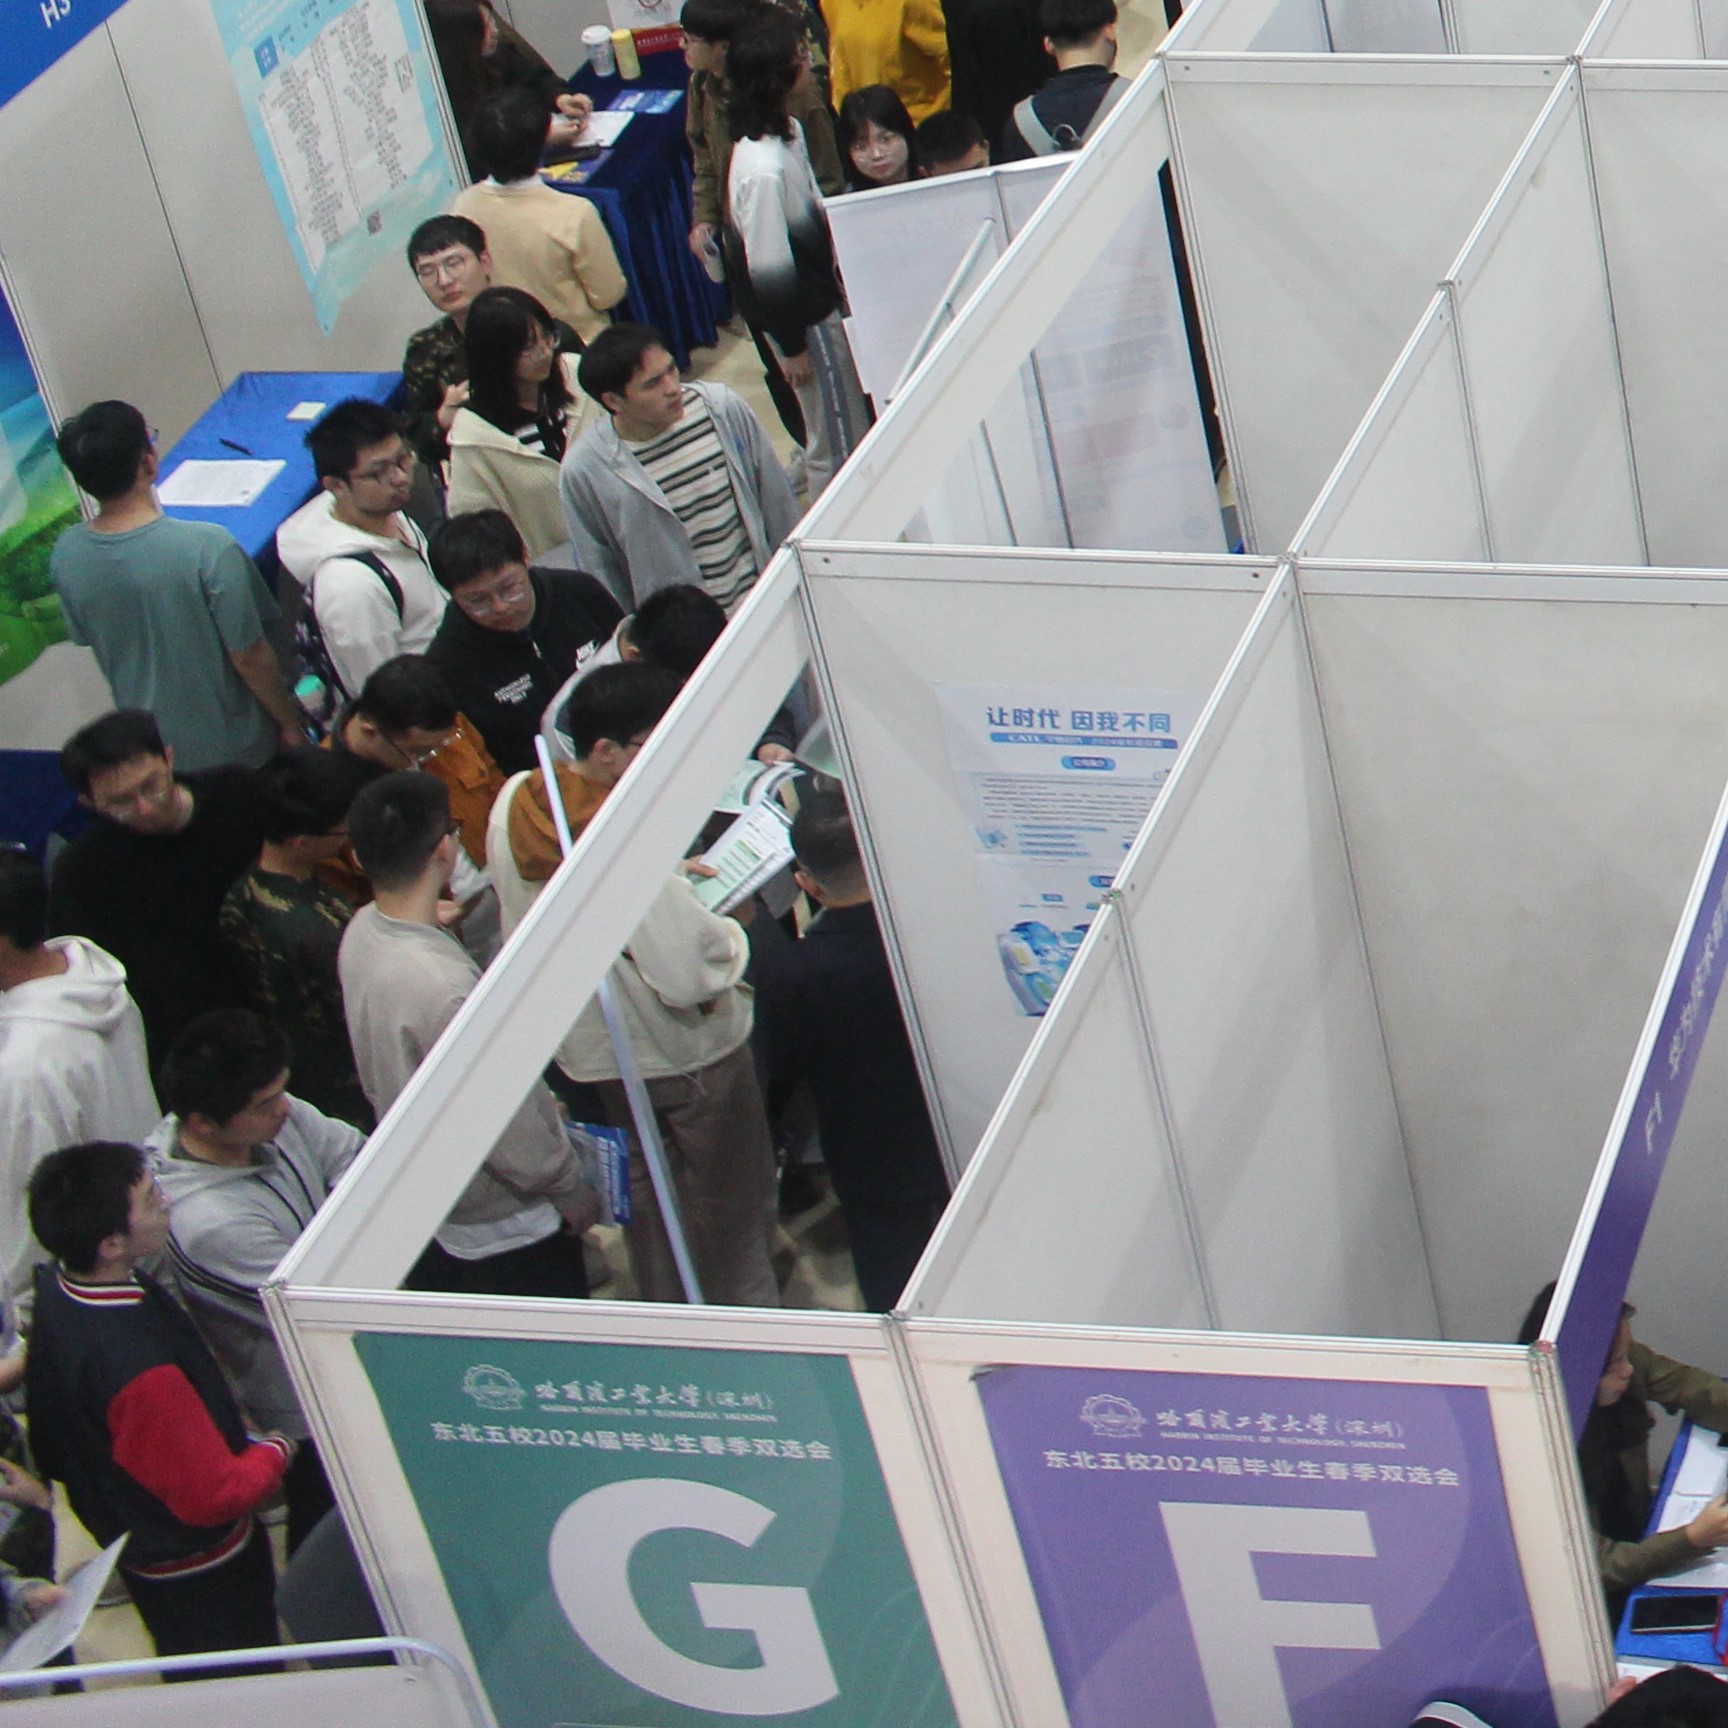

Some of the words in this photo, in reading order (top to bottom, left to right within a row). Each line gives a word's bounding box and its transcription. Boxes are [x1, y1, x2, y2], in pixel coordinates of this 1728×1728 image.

[986, 706, 1061, 729] 让时代
[1070, 710, 1171, 733] 因我不同
[1645, 1098, 1664, 1154] F1
[430, 1420, 833, 1462] 东北五校2024届毕业生春季双选会
[1043, 1448, 1461, 1488] 东北五校2024届毕业生春季双选会
[548, 1477, 841, 1716] G
[1158, 1501, 1383, 1728] F
